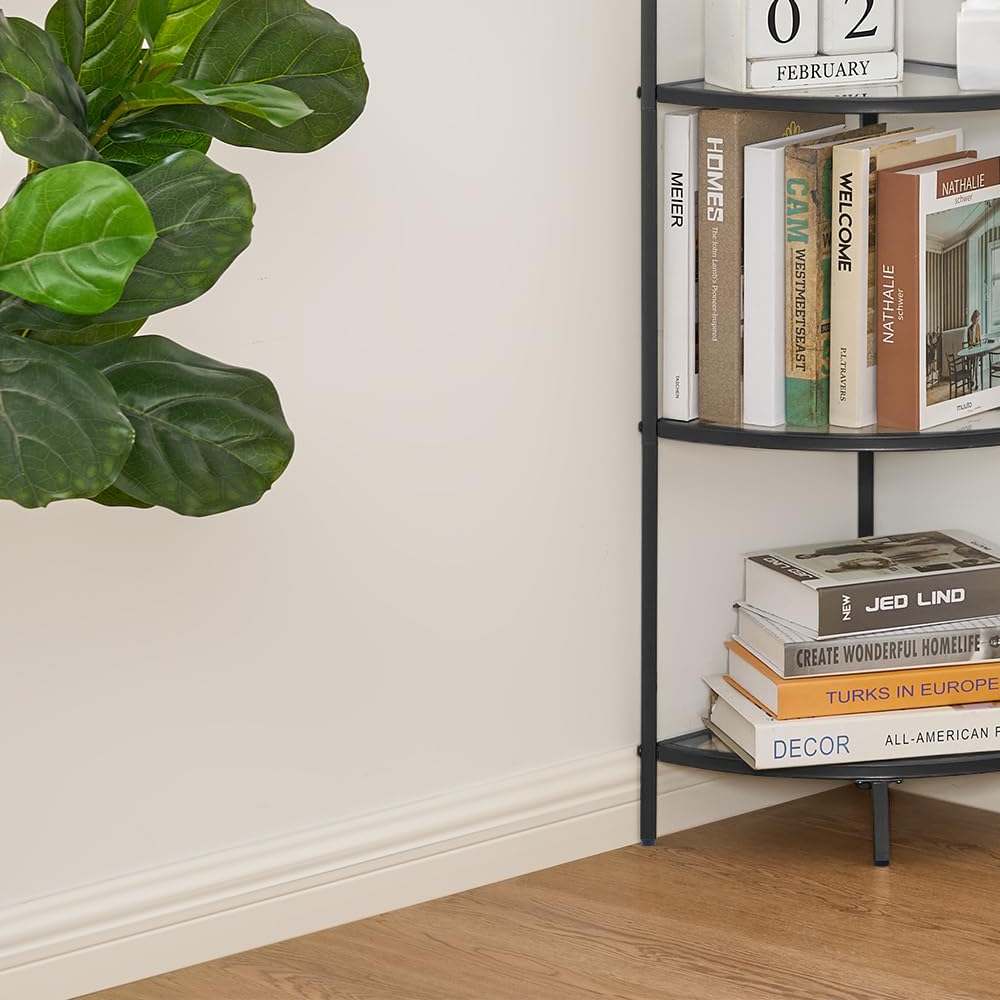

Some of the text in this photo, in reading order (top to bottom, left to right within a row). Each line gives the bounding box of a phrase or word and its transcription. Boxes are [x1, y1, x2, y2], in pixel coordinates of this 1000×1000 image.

[777, 61, 870, 81] FEBRUARY
[707, 137, 723, 222] HOMES
[942, 173, 985, 196] NATHALIE
[671, 172, 683, 227] MEIER
[786, 176, 809, 244] CAM
[838, 172, 853, 272] WELCOME
[795, 248, 806, 372] WESTMEETSEAST
[882, 264, 894, 343] NATHALIE
[896, 289, 904, 320] schwer
[842, 594, 851, 621] NEW
[865, 588, 965, 613] JED LIND
[796, 634, 980, 667] CREATE WONDERFUL HOMELIFE
[826, 677, 1000, 704] TURKS IN EUROPE
[773, 735, 850, 760] DECOR
[885, 726, 989, 746] ALL-AMERICAN
